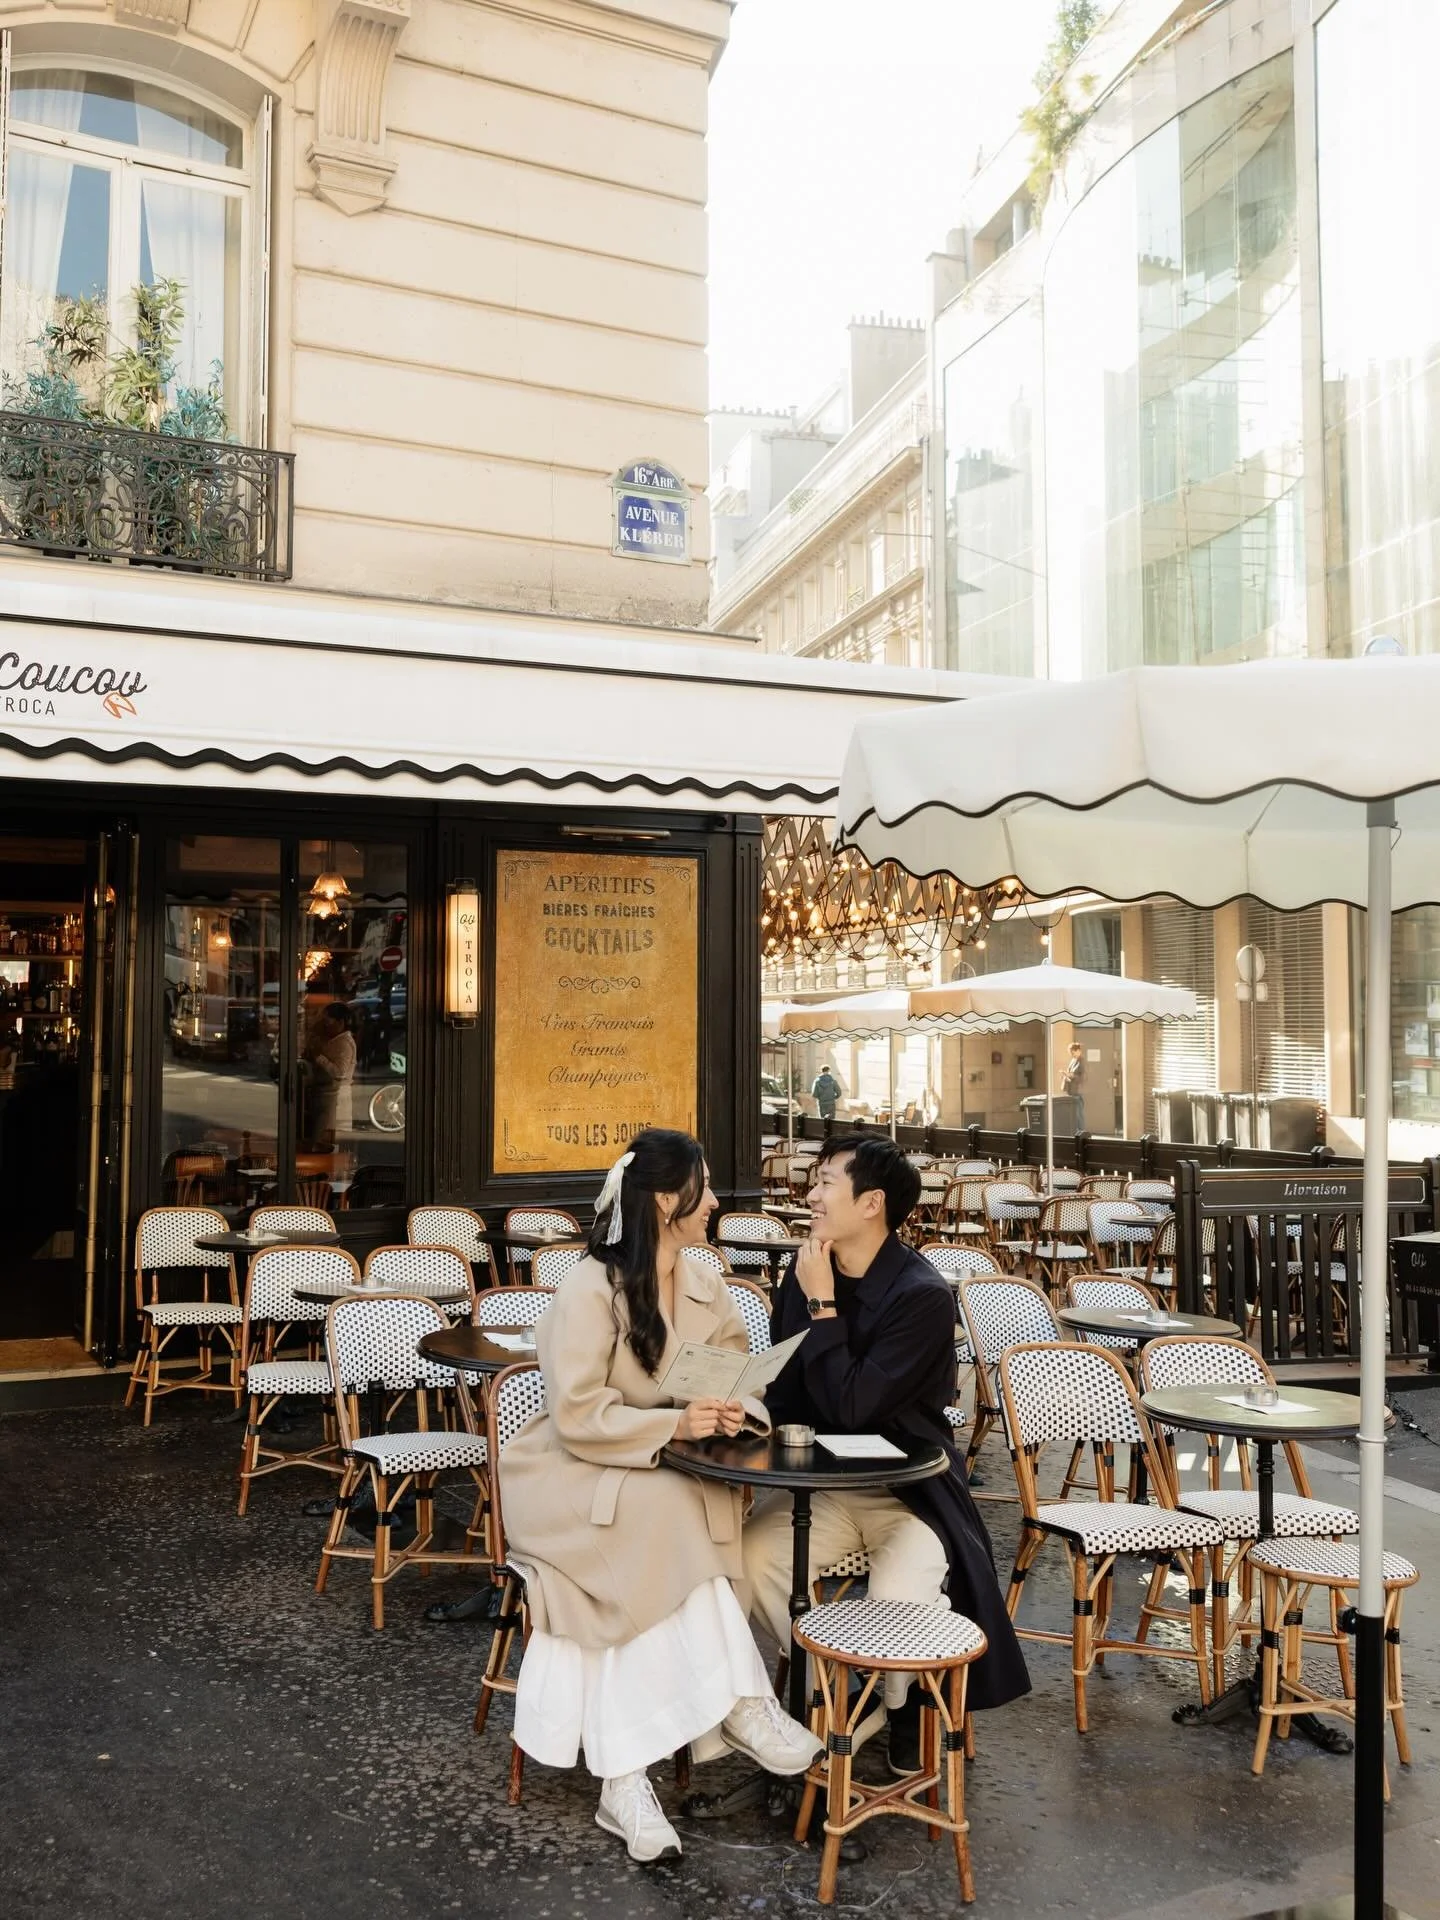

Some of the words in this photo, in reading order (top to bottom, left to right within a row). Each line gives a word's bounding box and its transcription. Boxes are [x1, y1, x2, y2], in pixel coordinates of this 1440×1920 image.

[626, 505, 679, 526] AVENUE
[620, 527, 684, 549] KLÉBER
[0, 652, 147, 697] Coucou
[0, 696, 55, 715] ROCA
[544, 871, 655, 895] APÉRITIFS
[543, 901, 588, 917] BIÈRES
[594, 902, 655, 919] FRAÎCHES
[545, 927, 654, 955] COCKTAILS
[465, 940, 473, 1004] TROCA
[540, 1014, 576, 1030] Vins
[548, 1065, 650, 1089] Champagnes
[546, 1124, 580, 1144] TOUS
[586, 1123, 607, 1146] LES
[1283, 1183, 1347, 1196] Livraison
